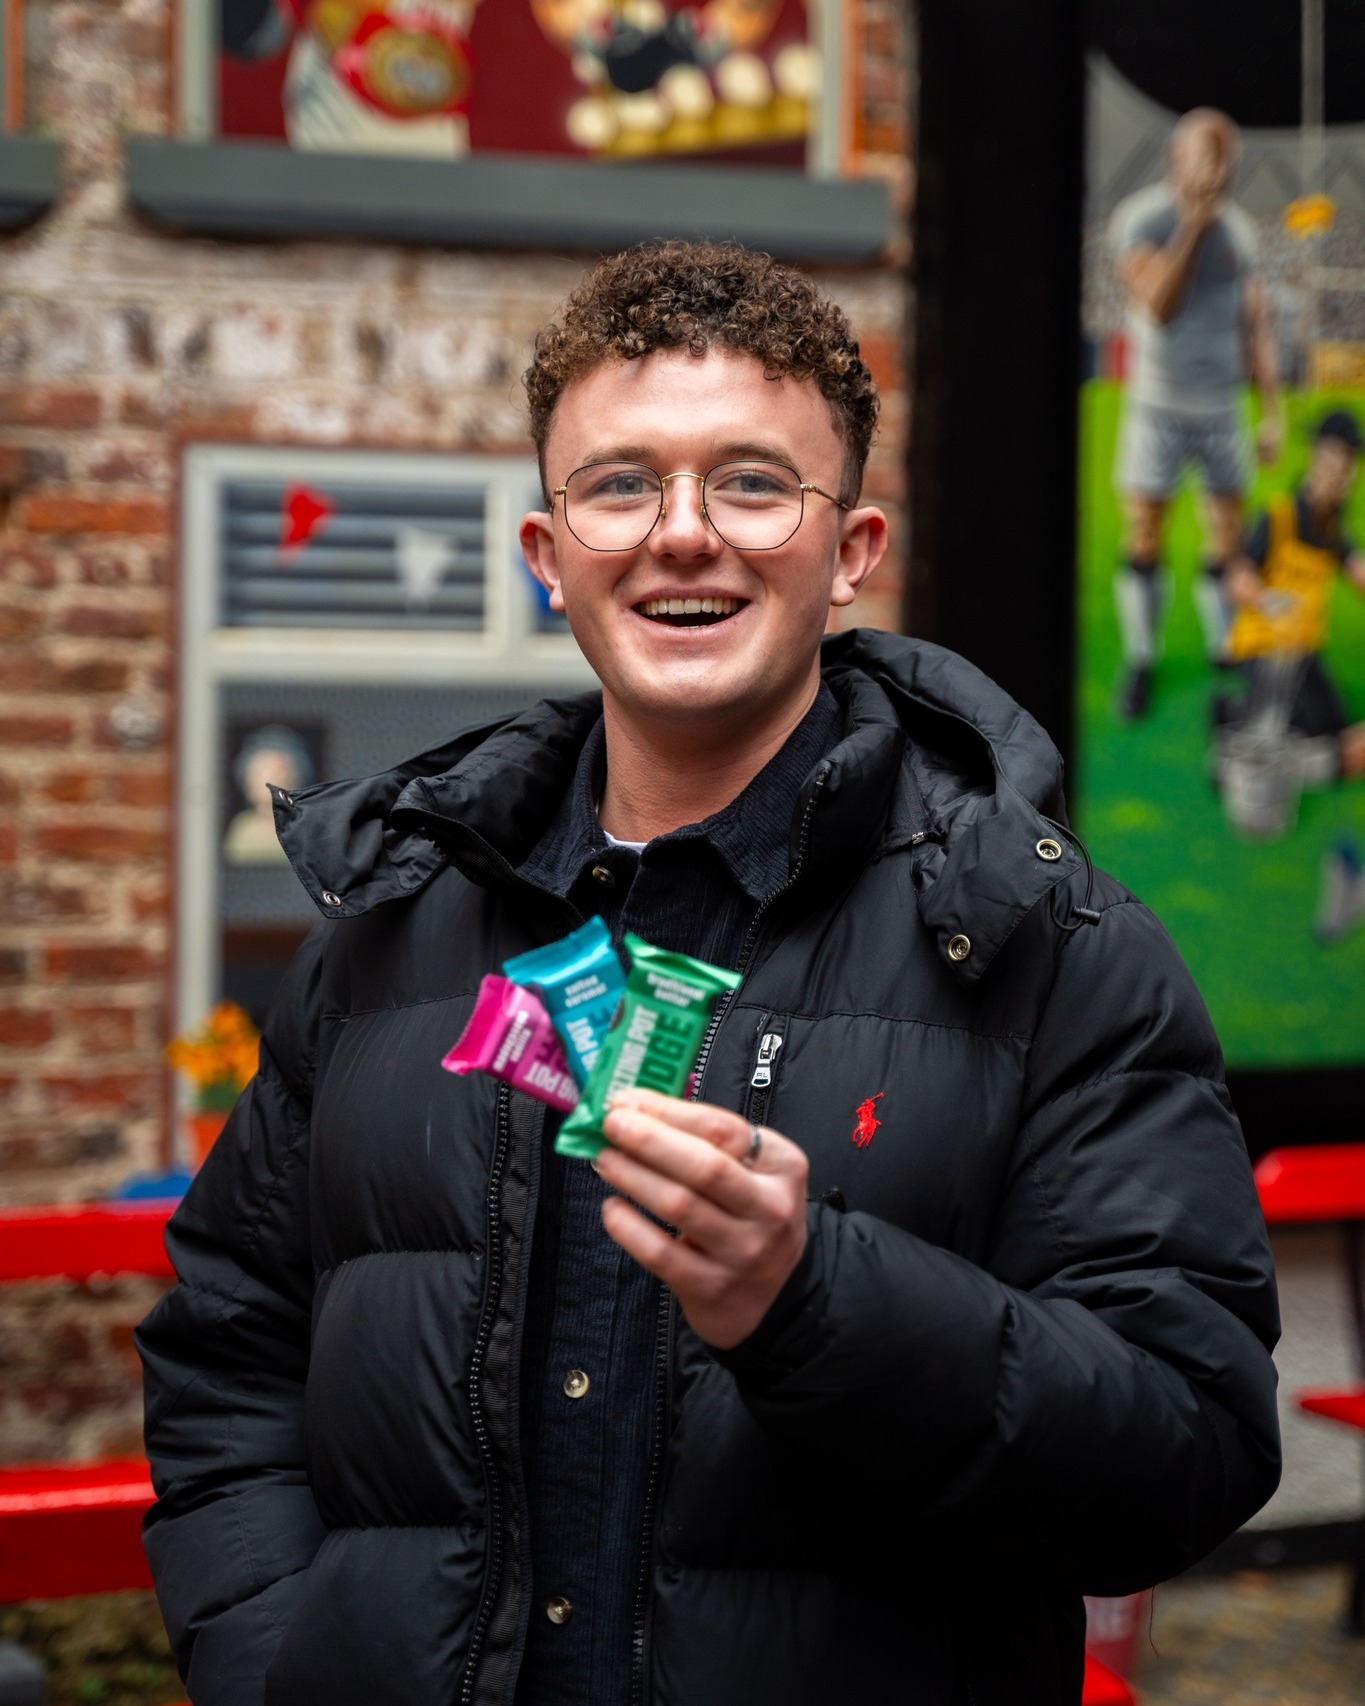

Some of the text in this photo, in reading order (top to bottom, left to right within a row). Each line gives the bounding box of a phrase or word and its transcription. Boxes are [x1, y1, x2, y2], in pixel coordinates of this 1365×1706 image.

[566, 1017, 599, 1053] POT
[626, 1003, 660, 1043] POT
[523, 1061, 562, 1093] POT
